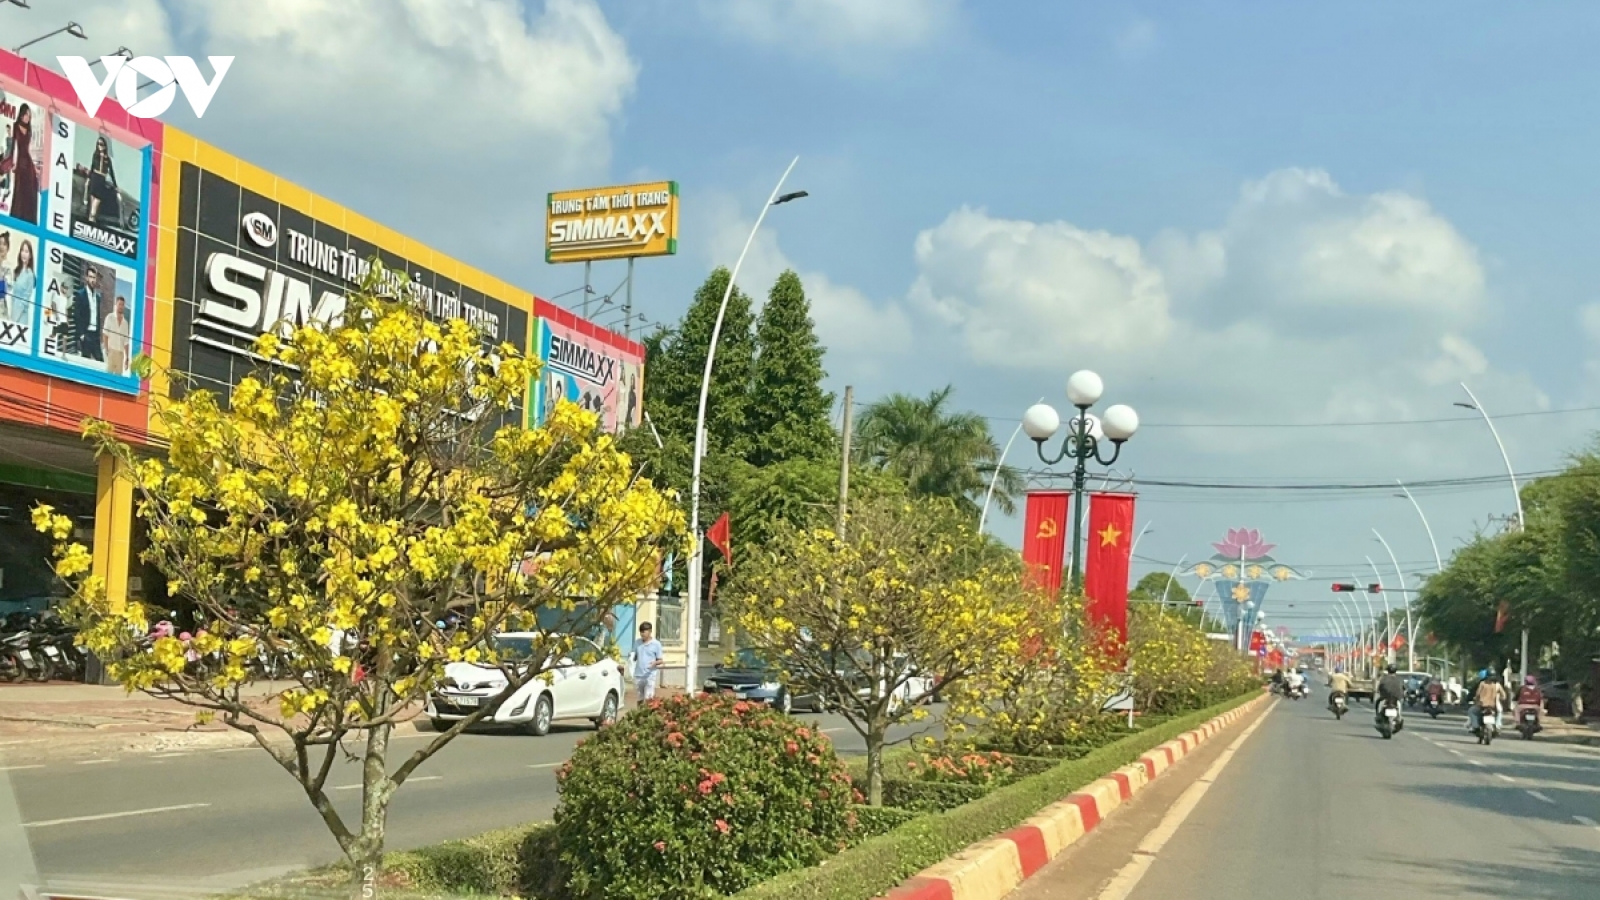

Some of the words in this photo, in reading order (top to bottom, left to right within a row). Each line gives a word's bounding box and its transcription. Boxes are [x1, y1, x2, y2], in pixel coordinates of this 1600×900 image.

[53, 121, 69, 231] SALE
[551, 200, 582, 215] TRUNG
[637, 190, 669, 207] TRANG
[73, 220, 136, 254] SIMMAXX
[253, 218, 273, 241] SM
[550, 211, 667, 243] SIMMAXX
[44, 248, 62, 356] SALE
[287, 228, 338, 276] TRUNG
[340, 248, 370, 286] TÂM
[463, 302, 499, 340] TRANG
[549, 335, 615, 386] SIMMAXX
